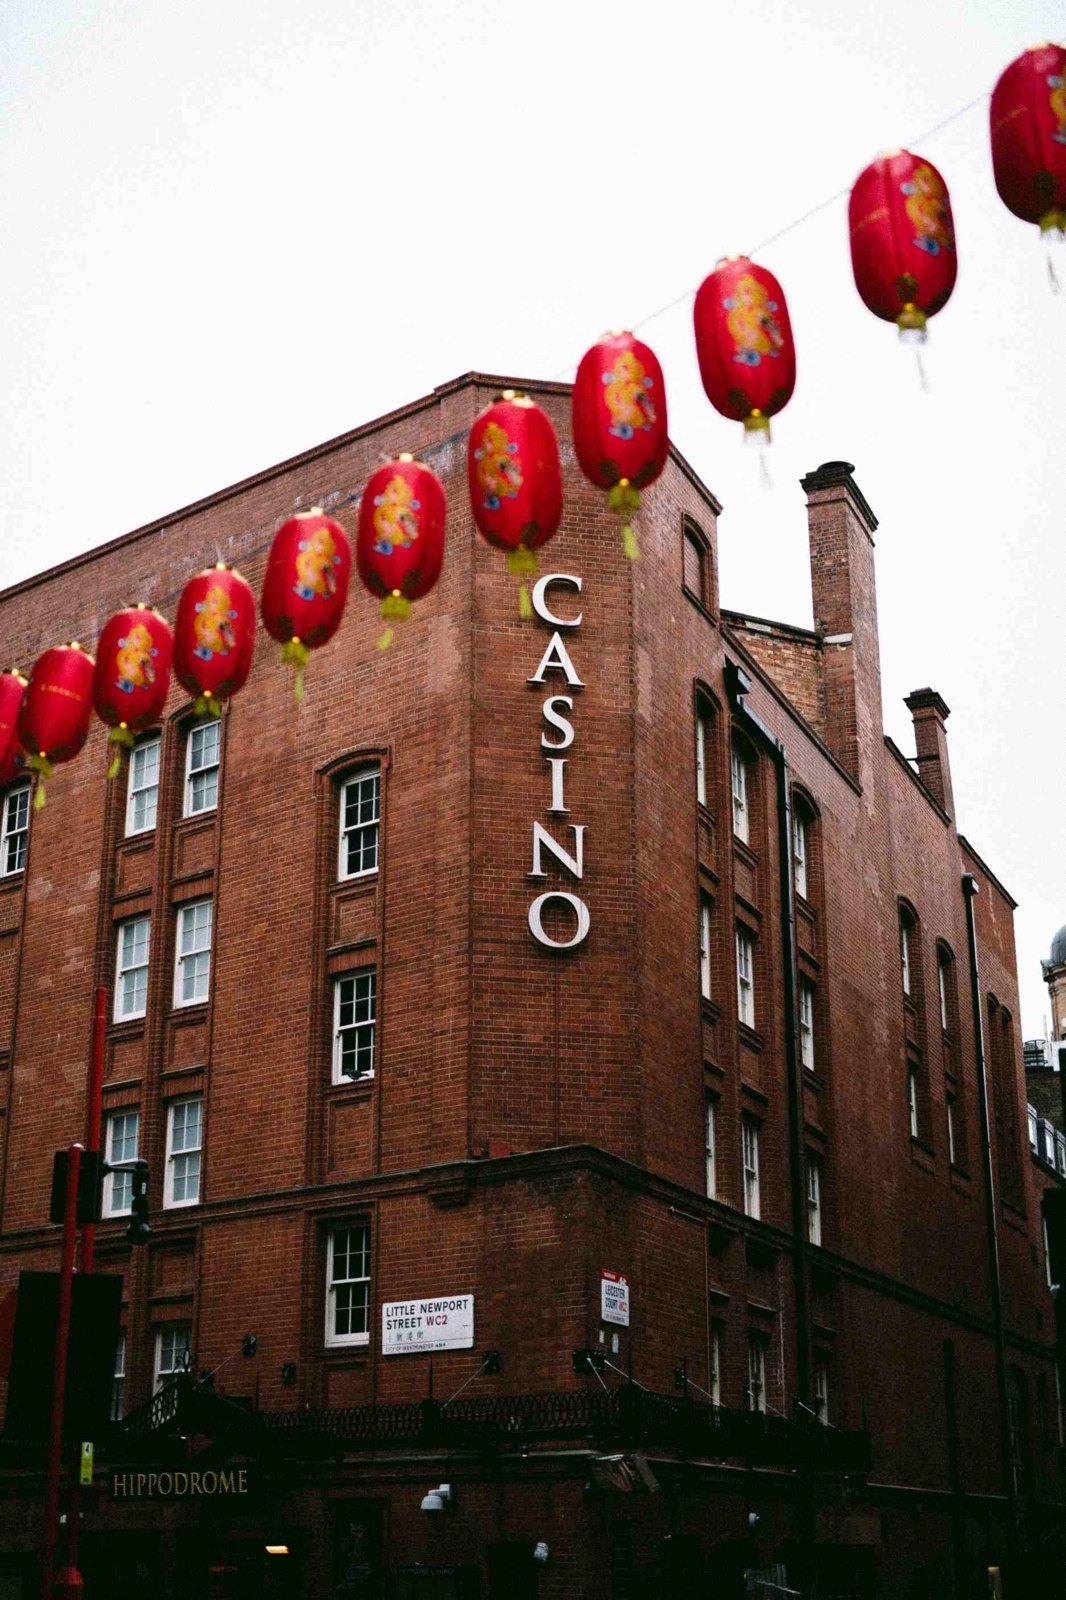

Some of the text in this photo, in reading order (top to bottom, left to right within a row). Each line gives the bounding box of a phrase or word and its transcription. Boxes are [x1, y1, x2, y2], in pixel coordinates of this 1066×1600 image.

[526, 573, 590, 948] CASINO
[386, 1299, 468, 1317] LITTLE NEWPORT
[386, 1314, 448, 1330] STREET WC2
[113, 1470, 248, 1497] HIPPODROME
